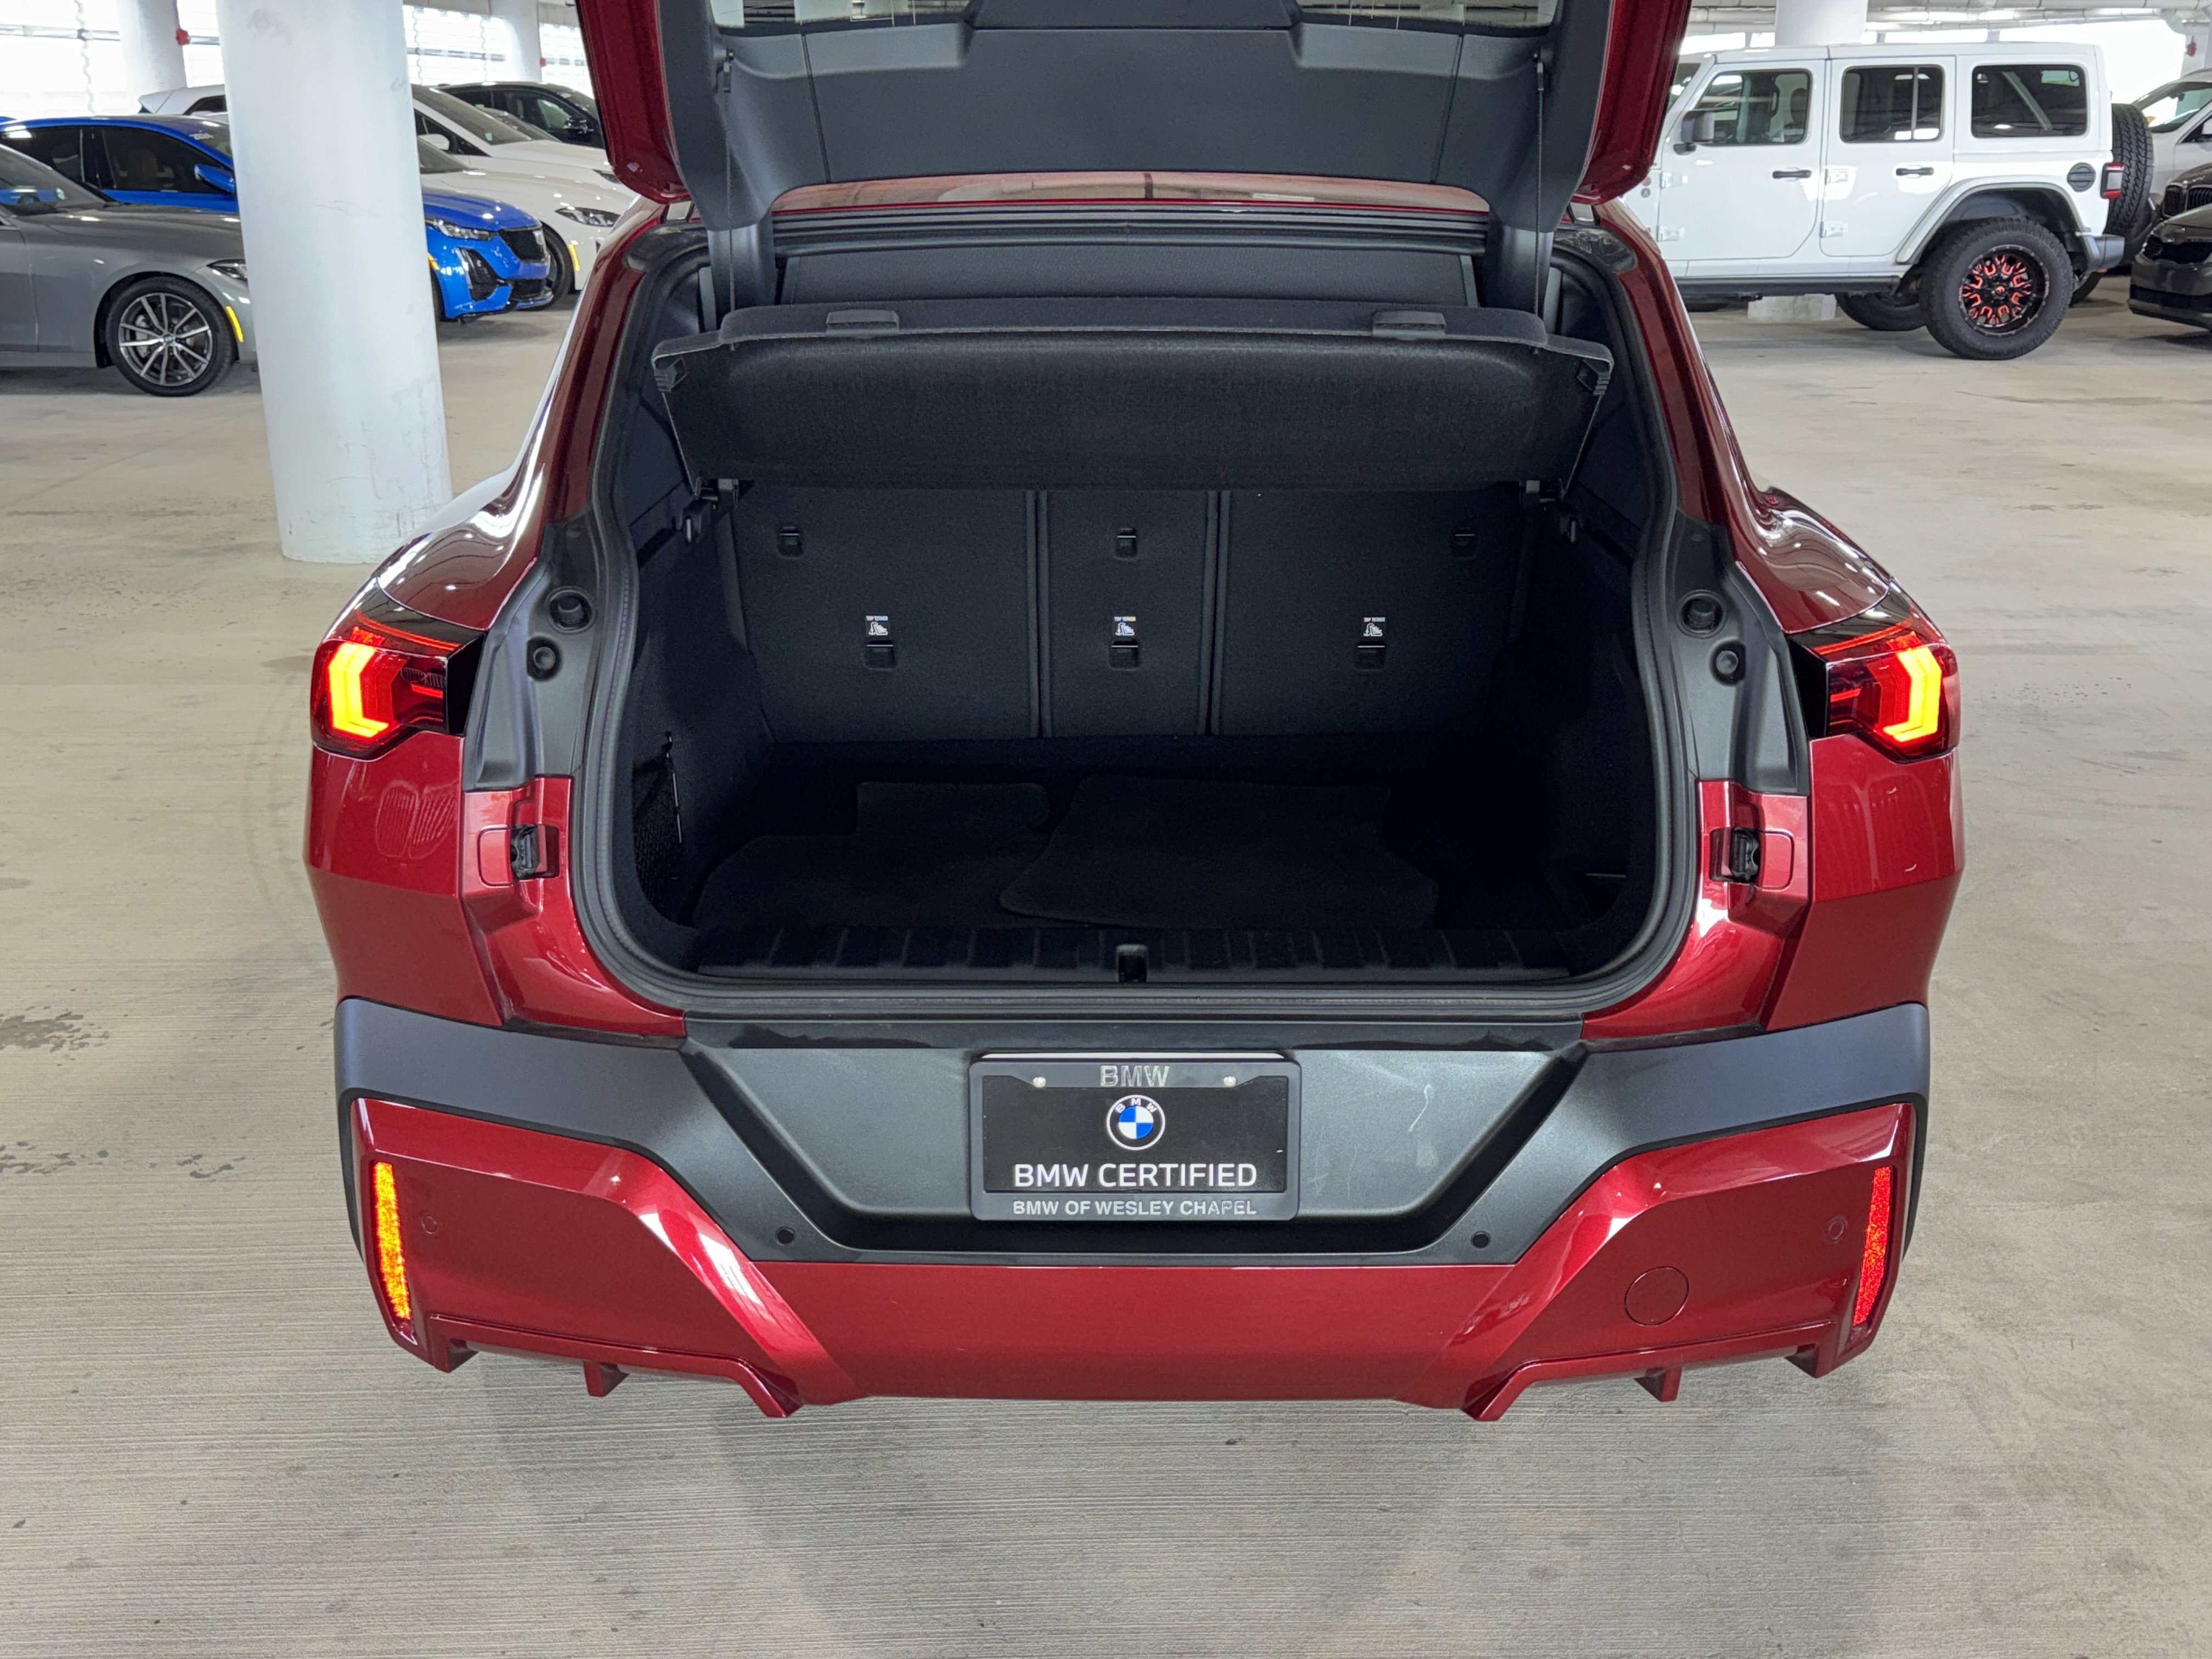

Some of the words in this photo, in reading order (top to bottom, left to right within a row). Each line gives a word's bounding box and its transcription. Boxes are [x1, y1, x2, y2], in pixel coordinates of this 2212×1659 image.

[1099, 1065, 1170, 1087] BMW
[1115, 1098, 1158, 1114] BMW
[1014, 1164, 1090, 1187] BMW
[1099, 1163, 1257, 1187] CERTIFIED
[1013, 1200, 1059, 1215] BMW
[1065, 1200, 1091, 1215] OF
[1095, 1200, 1174, 1216] WESLEY
[1180, 1200, 1257, 1215] CHAPEL
